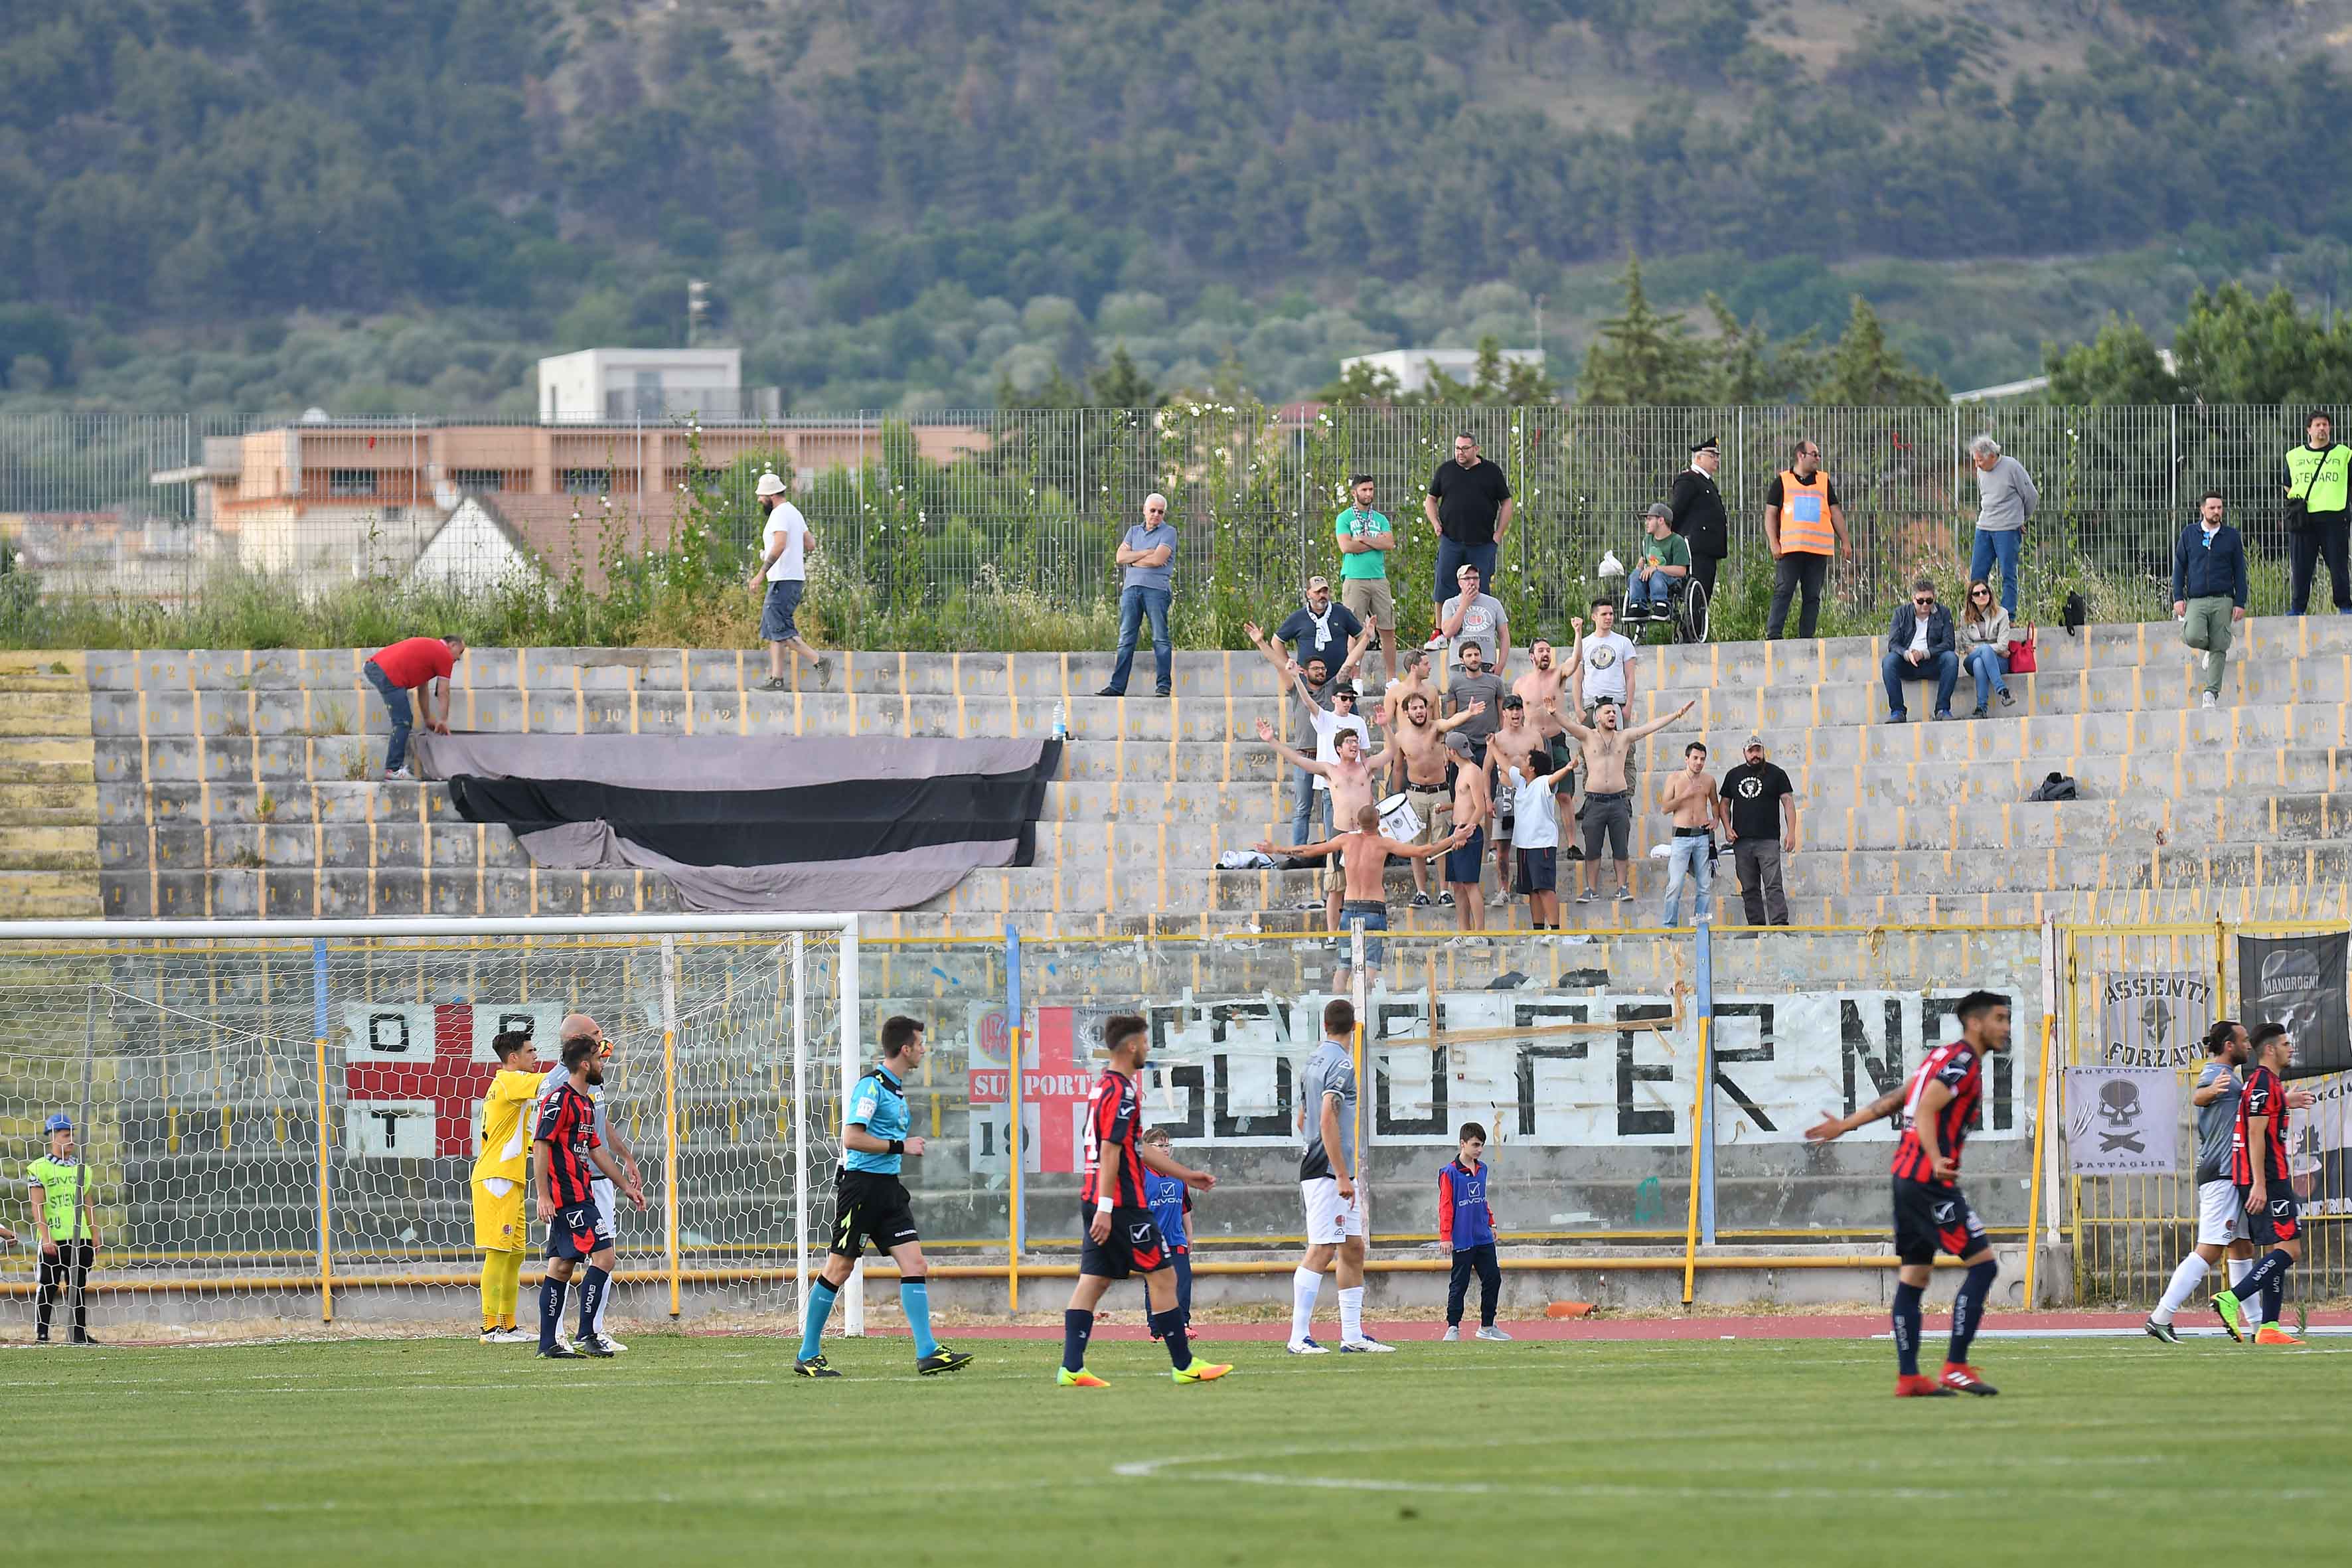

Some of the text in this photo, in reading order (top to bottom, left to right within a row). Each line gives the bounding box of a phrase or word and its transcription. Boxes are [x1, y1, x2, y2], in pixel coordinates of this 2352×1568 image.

[2104, 979, 2211, 1005] ASSENTI
[2262, 975, 2319, 995] MANDROGNI
[1514, 1002, 1778, 1137] PER
[371, 1109, 411, 1148] T
[2075, 1160, 2165, 1169] BATTAGLIE
[585, 1284, 596, 1314] GIVOVA
